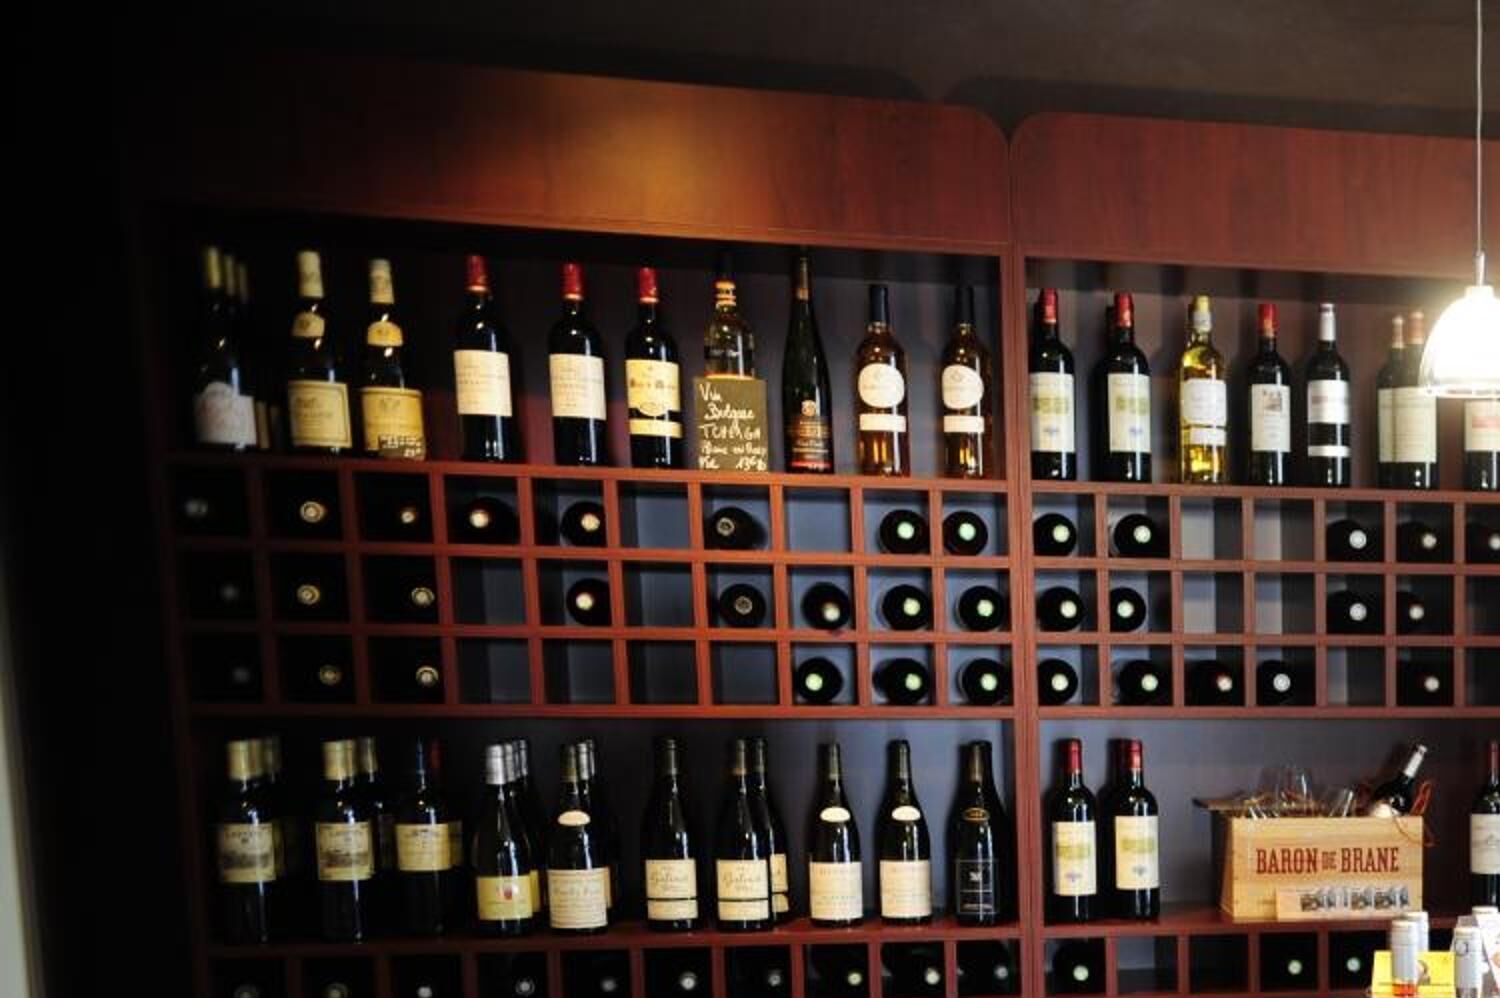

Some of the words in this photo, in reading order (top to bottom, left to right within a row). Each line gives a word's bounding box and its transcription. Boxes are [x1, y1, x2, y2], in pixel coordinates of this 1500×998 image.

[1256, 848, 1319, 874] BARON
[1321, 850, 1338, 870] DE
[1341, 847, 1400, 873] BRANE
